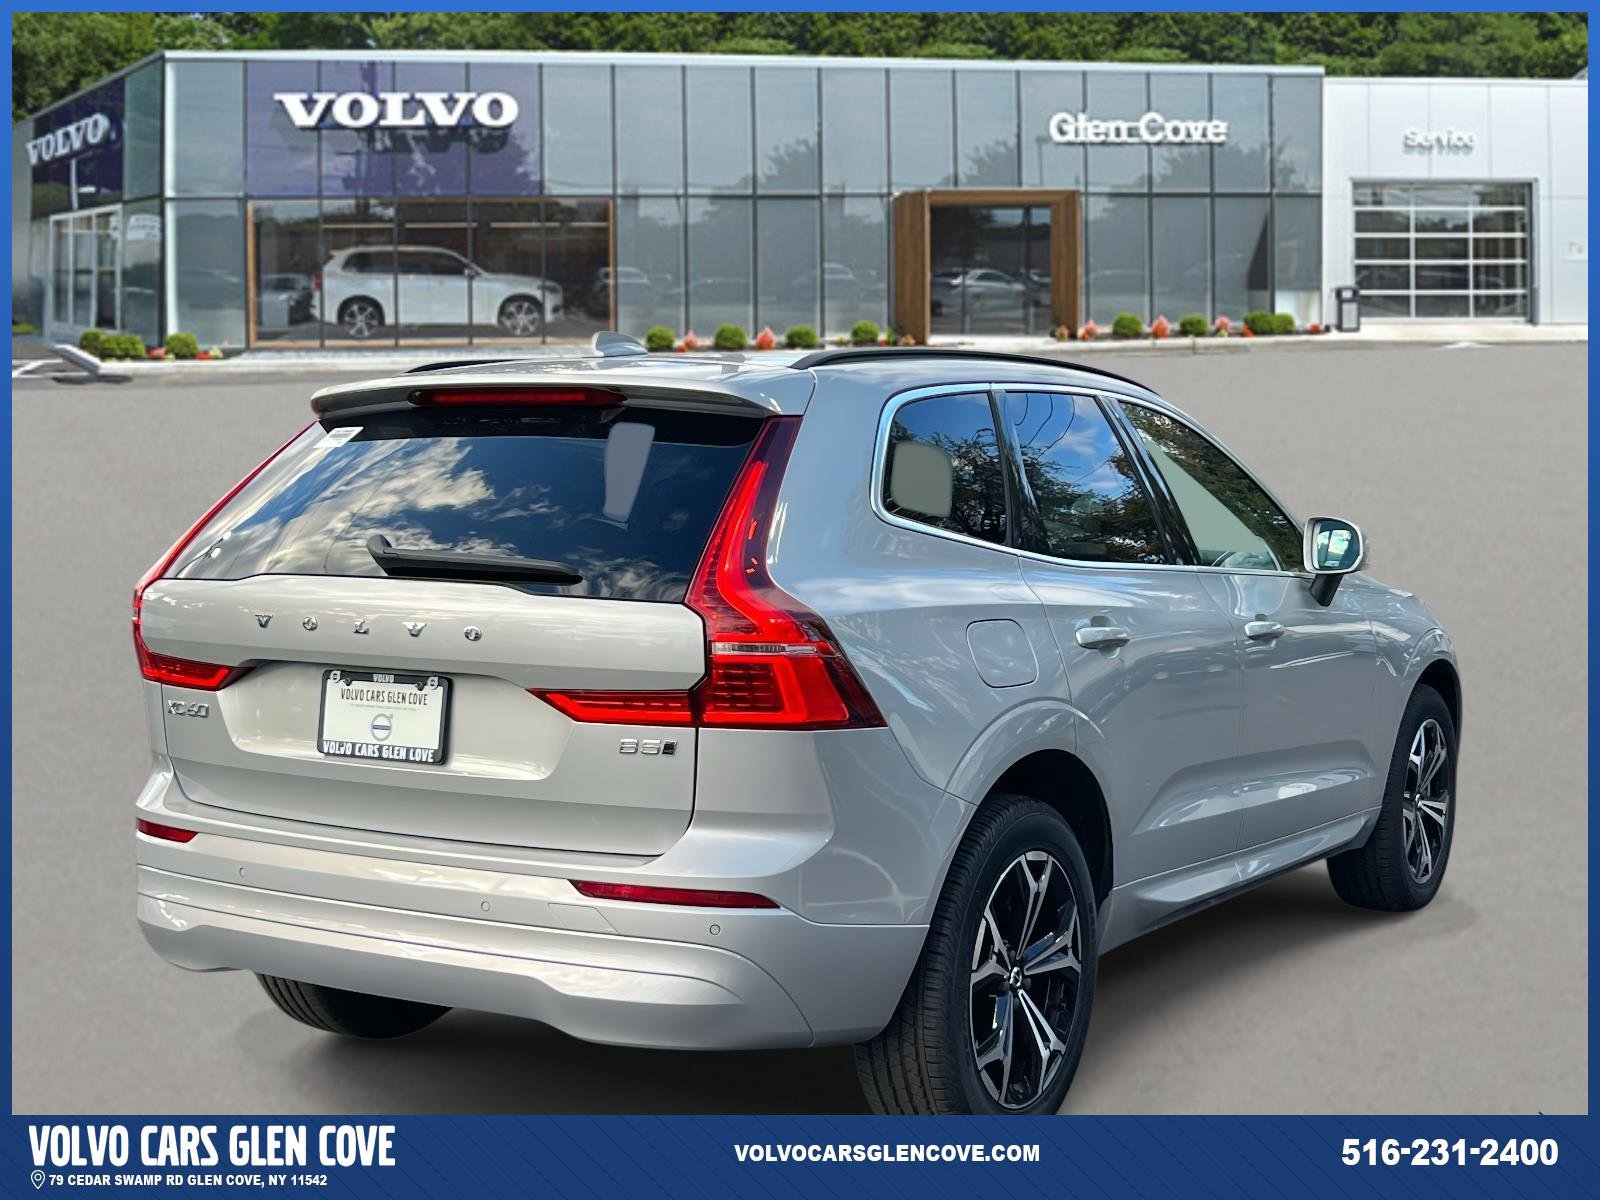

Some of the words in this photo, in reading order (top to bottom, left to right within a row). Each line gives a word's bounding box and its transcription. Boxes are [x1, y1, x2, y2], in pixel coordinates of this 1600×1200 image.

[274, 92, 518, 127] VOLVO
[26, 112, 110, 165] VOLVO
[1049, 111, 1129, 143] Glen
[1139, 111, 1227, 143] Cove
[1403, 127, 1477, 151] Service
[255, 614, 483, 642] VOLVO
[372, 673, 395, 683] VOLVO
[340, 687, 365, 701] VOLVO
[365, 689, 386, 703] CARS
[387, 691, 407, 704] GLEN
[408, 692, 428, 706] COVE
[167, 699, 210, 719] XC60
[323, 740, 353, 755] VOLVO
[354, 743, 380, 758] CARS
[382, 745, 407, 760] GLEN
